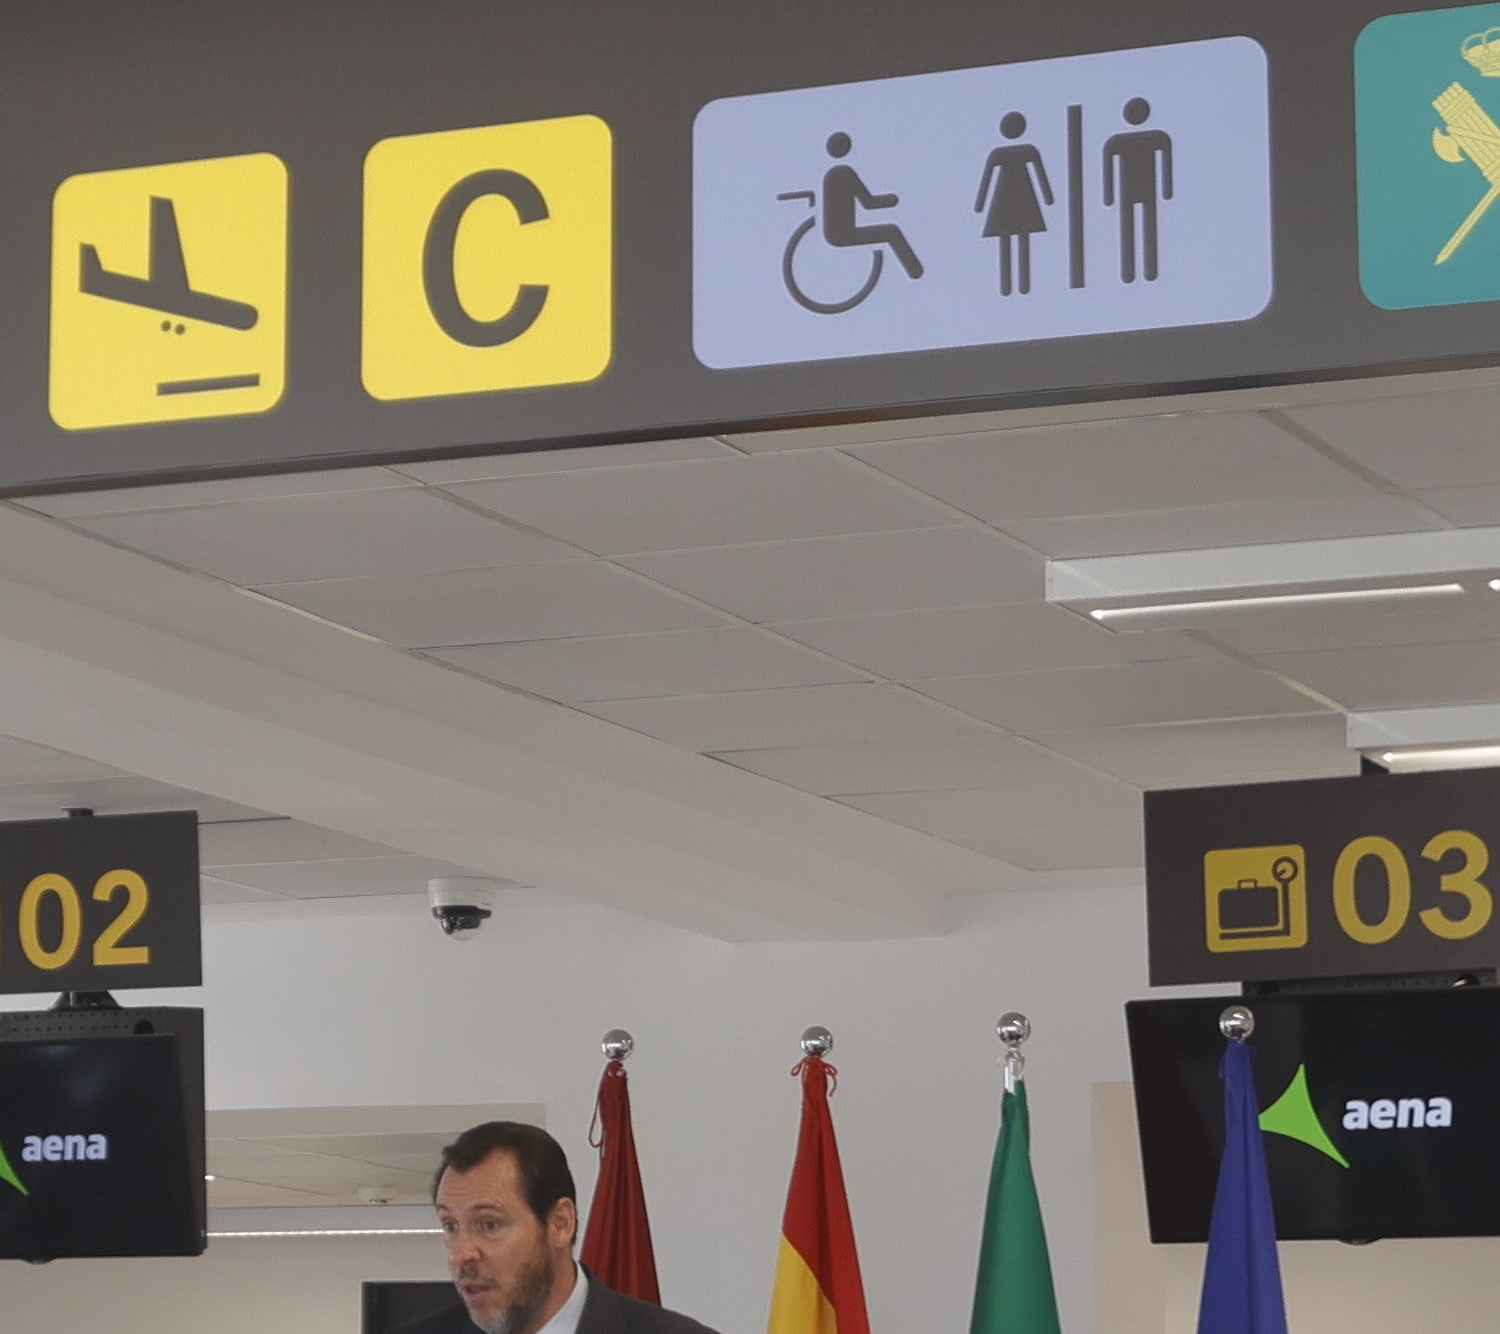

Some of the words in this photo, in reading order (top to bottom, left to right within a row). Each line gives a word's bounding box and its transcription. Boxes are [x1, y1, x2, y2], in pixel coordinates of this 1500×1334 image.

[421, 168, 551, 348] C
[18, 869, 151, 969] 02
[1332, 829, 1494, 945] 03
[21, 1131, 109, 1162] aena
[1342, 1095, 1453, 1131] aena
